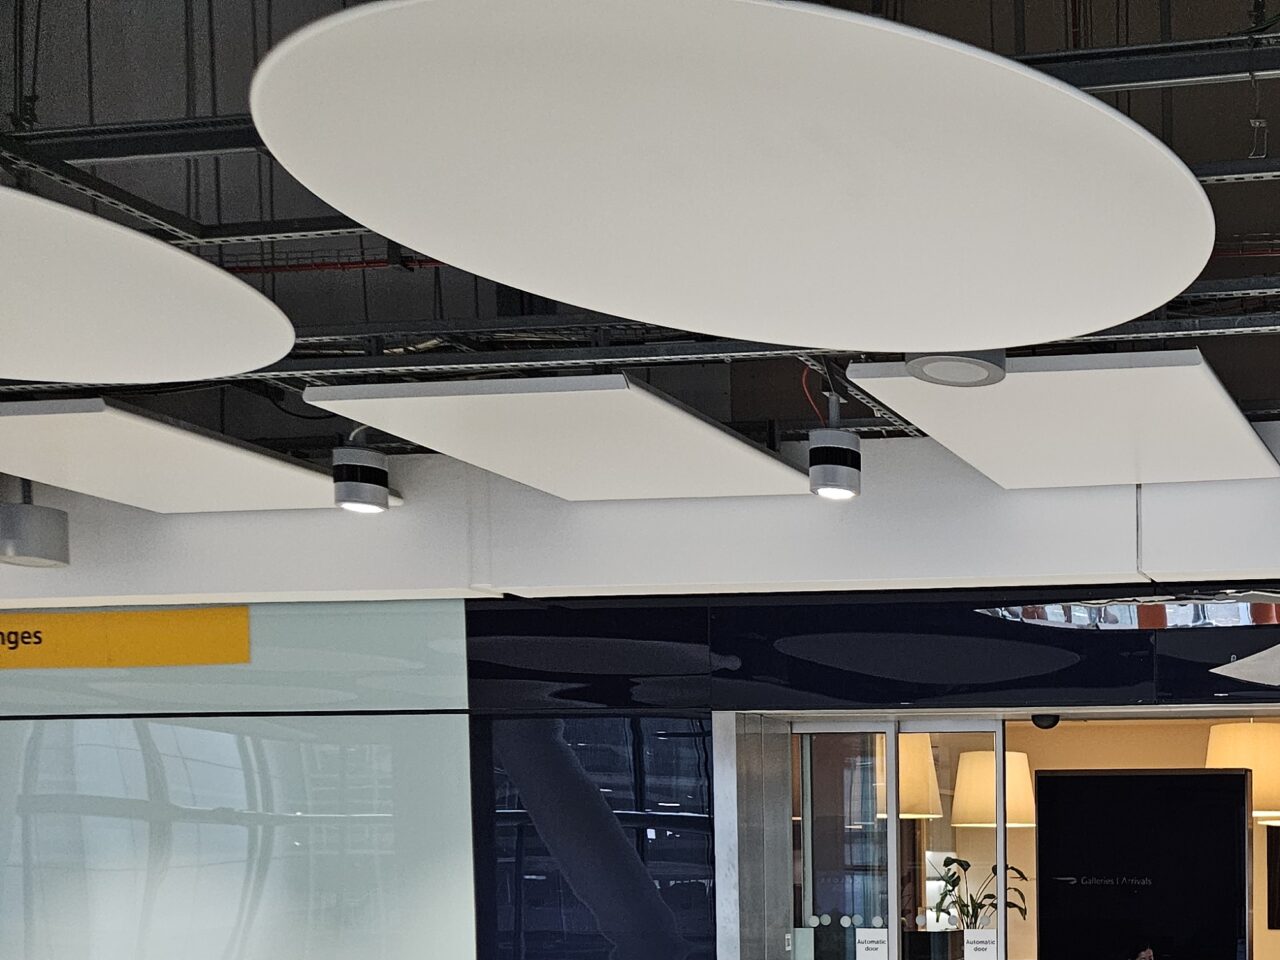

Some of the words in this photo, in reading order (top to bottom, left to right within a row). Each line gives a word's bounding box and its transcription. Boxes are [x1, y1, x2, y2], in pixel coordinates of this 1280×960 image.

[1081, 876, 1115, 885] Galleries
[1121, 876, 1152, 885] Arrivals
[857, 938, 886, 946] Automatic
[965, 938, 996, 946] Automatic
